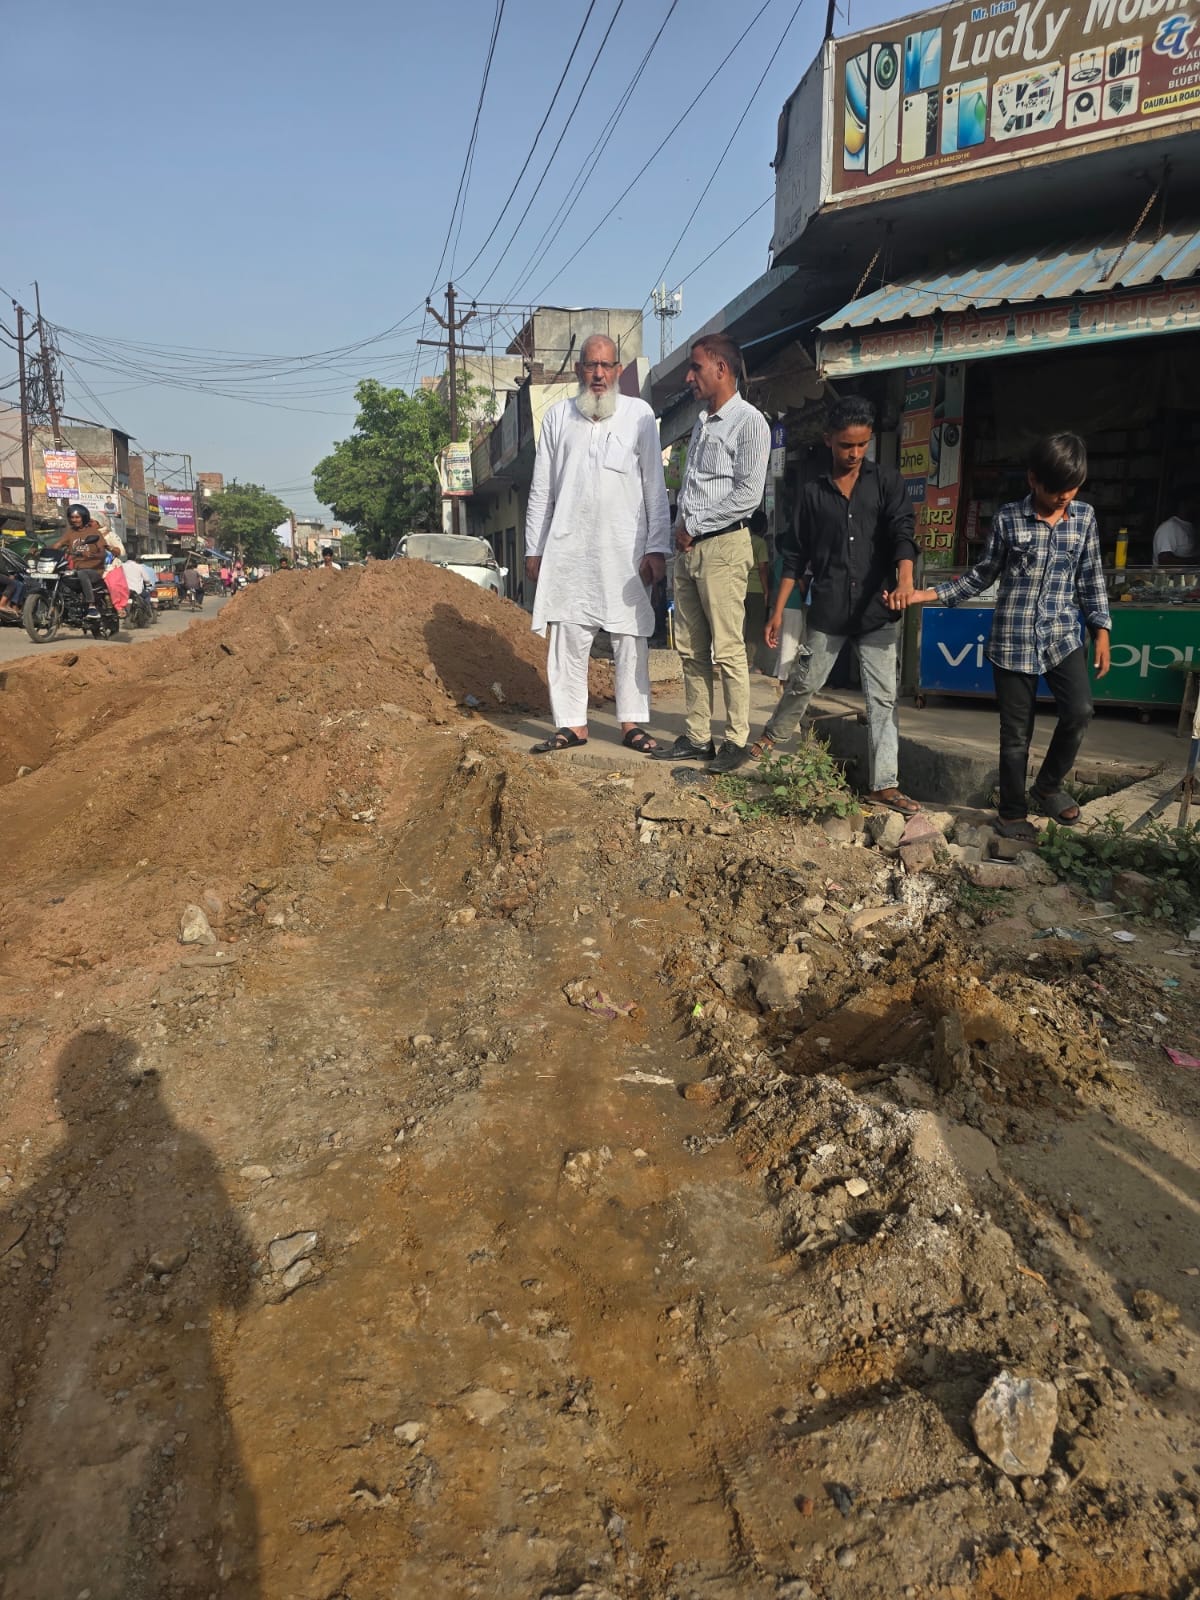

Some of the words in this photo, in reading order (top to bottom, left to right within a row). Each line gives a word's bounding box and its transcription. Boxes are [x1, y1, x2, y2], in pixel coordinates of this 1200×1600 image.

[971, 8, 989, 22] Mr.
[990, 0, 1017, 17] Irfan
[1168, 74, 1200, 89] BLUET
[1143, 94, 1178, 110] DAURALA
